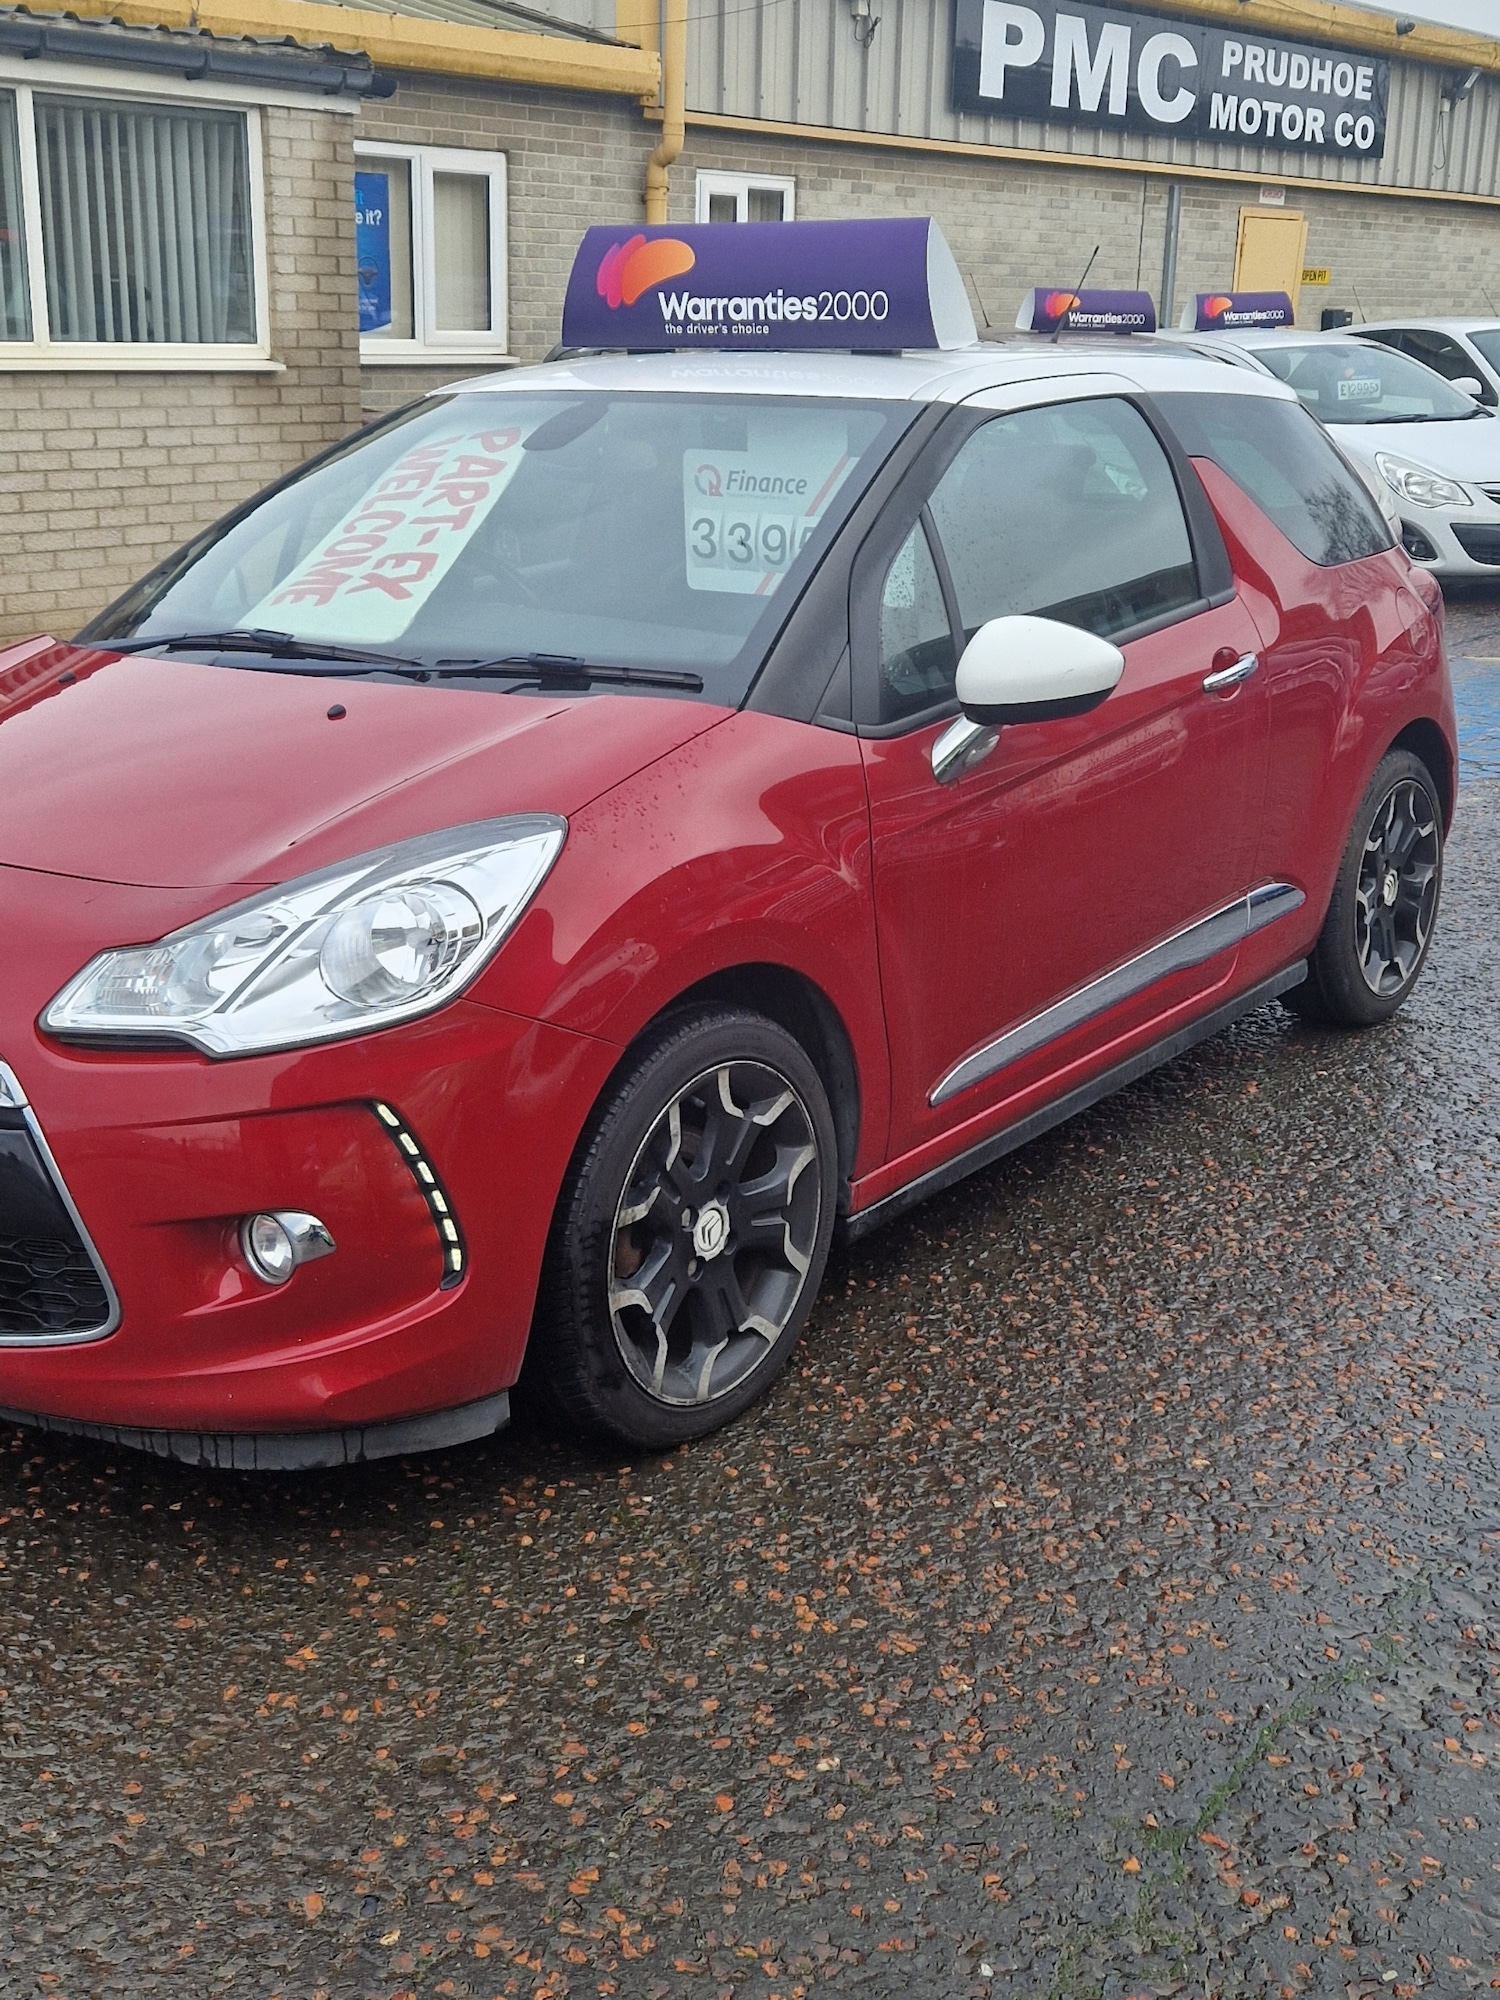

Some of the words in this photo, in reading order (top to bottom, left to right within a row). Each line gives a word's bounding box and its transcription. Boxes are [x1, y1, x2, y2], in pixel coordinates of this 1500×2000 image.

[979, 0, 1198, 123] PMC
[1221, 39, 1374, 101] PRUDHOE
[1209, 92, 1326, 143] MOTOR
[1334, 112, 1375, 149] CO
[365, 208, 382, 225] it?
[1302, 269, 1317, 281] OPEN
[1318, 269, 1327, 280] PIT
[658, 289, 888, 321] Warranties2000
[1068, 312, 1145, 324] Warranties2000
[665, 323, 683, 334] the
[686, 322, 728, 334] driver's
[731, 323, 769, 334] choice
[726, 469, 808, 495] Finance
[270, 434, 466, 607] WELCOME
[344, 426, 522, 601] PART-EX
[692, 517, 816, 567] 339
